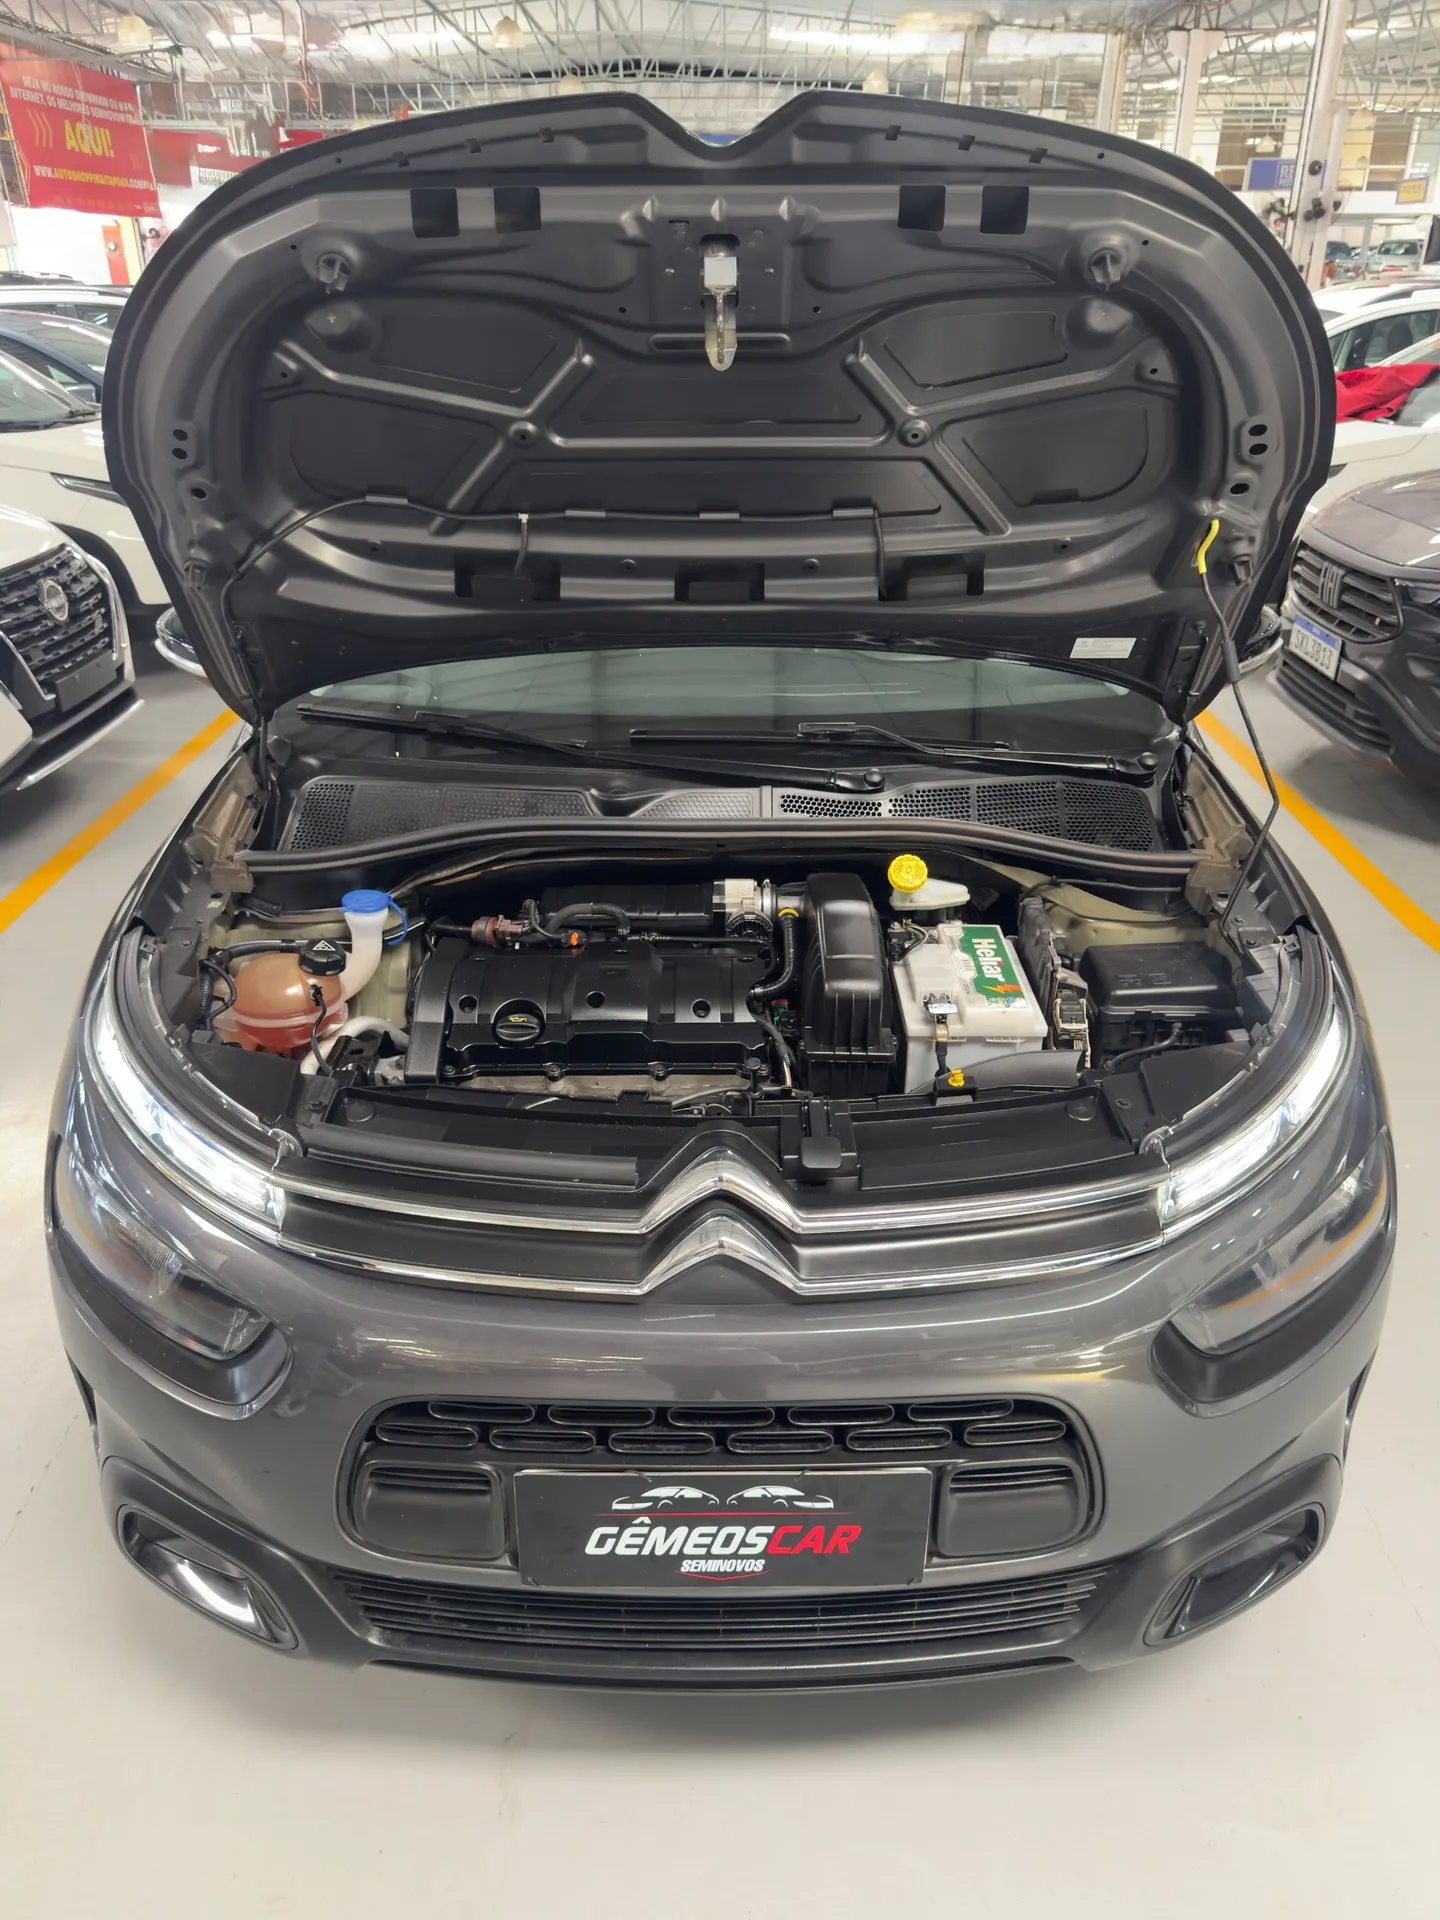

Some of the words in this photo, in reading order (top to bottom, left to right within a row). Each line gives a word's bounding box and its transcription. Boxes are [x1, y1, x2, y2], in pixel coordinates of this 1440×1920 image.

[64, 119, 115, 158] AQUI!
[1318, 560, 1346, 609] FIAT
[1294, 629, 1333, 670] SKL3B13
[971, 938, 1006, 983] Heliar
[680, 1559, 765, 1573] SEMINOVOS
